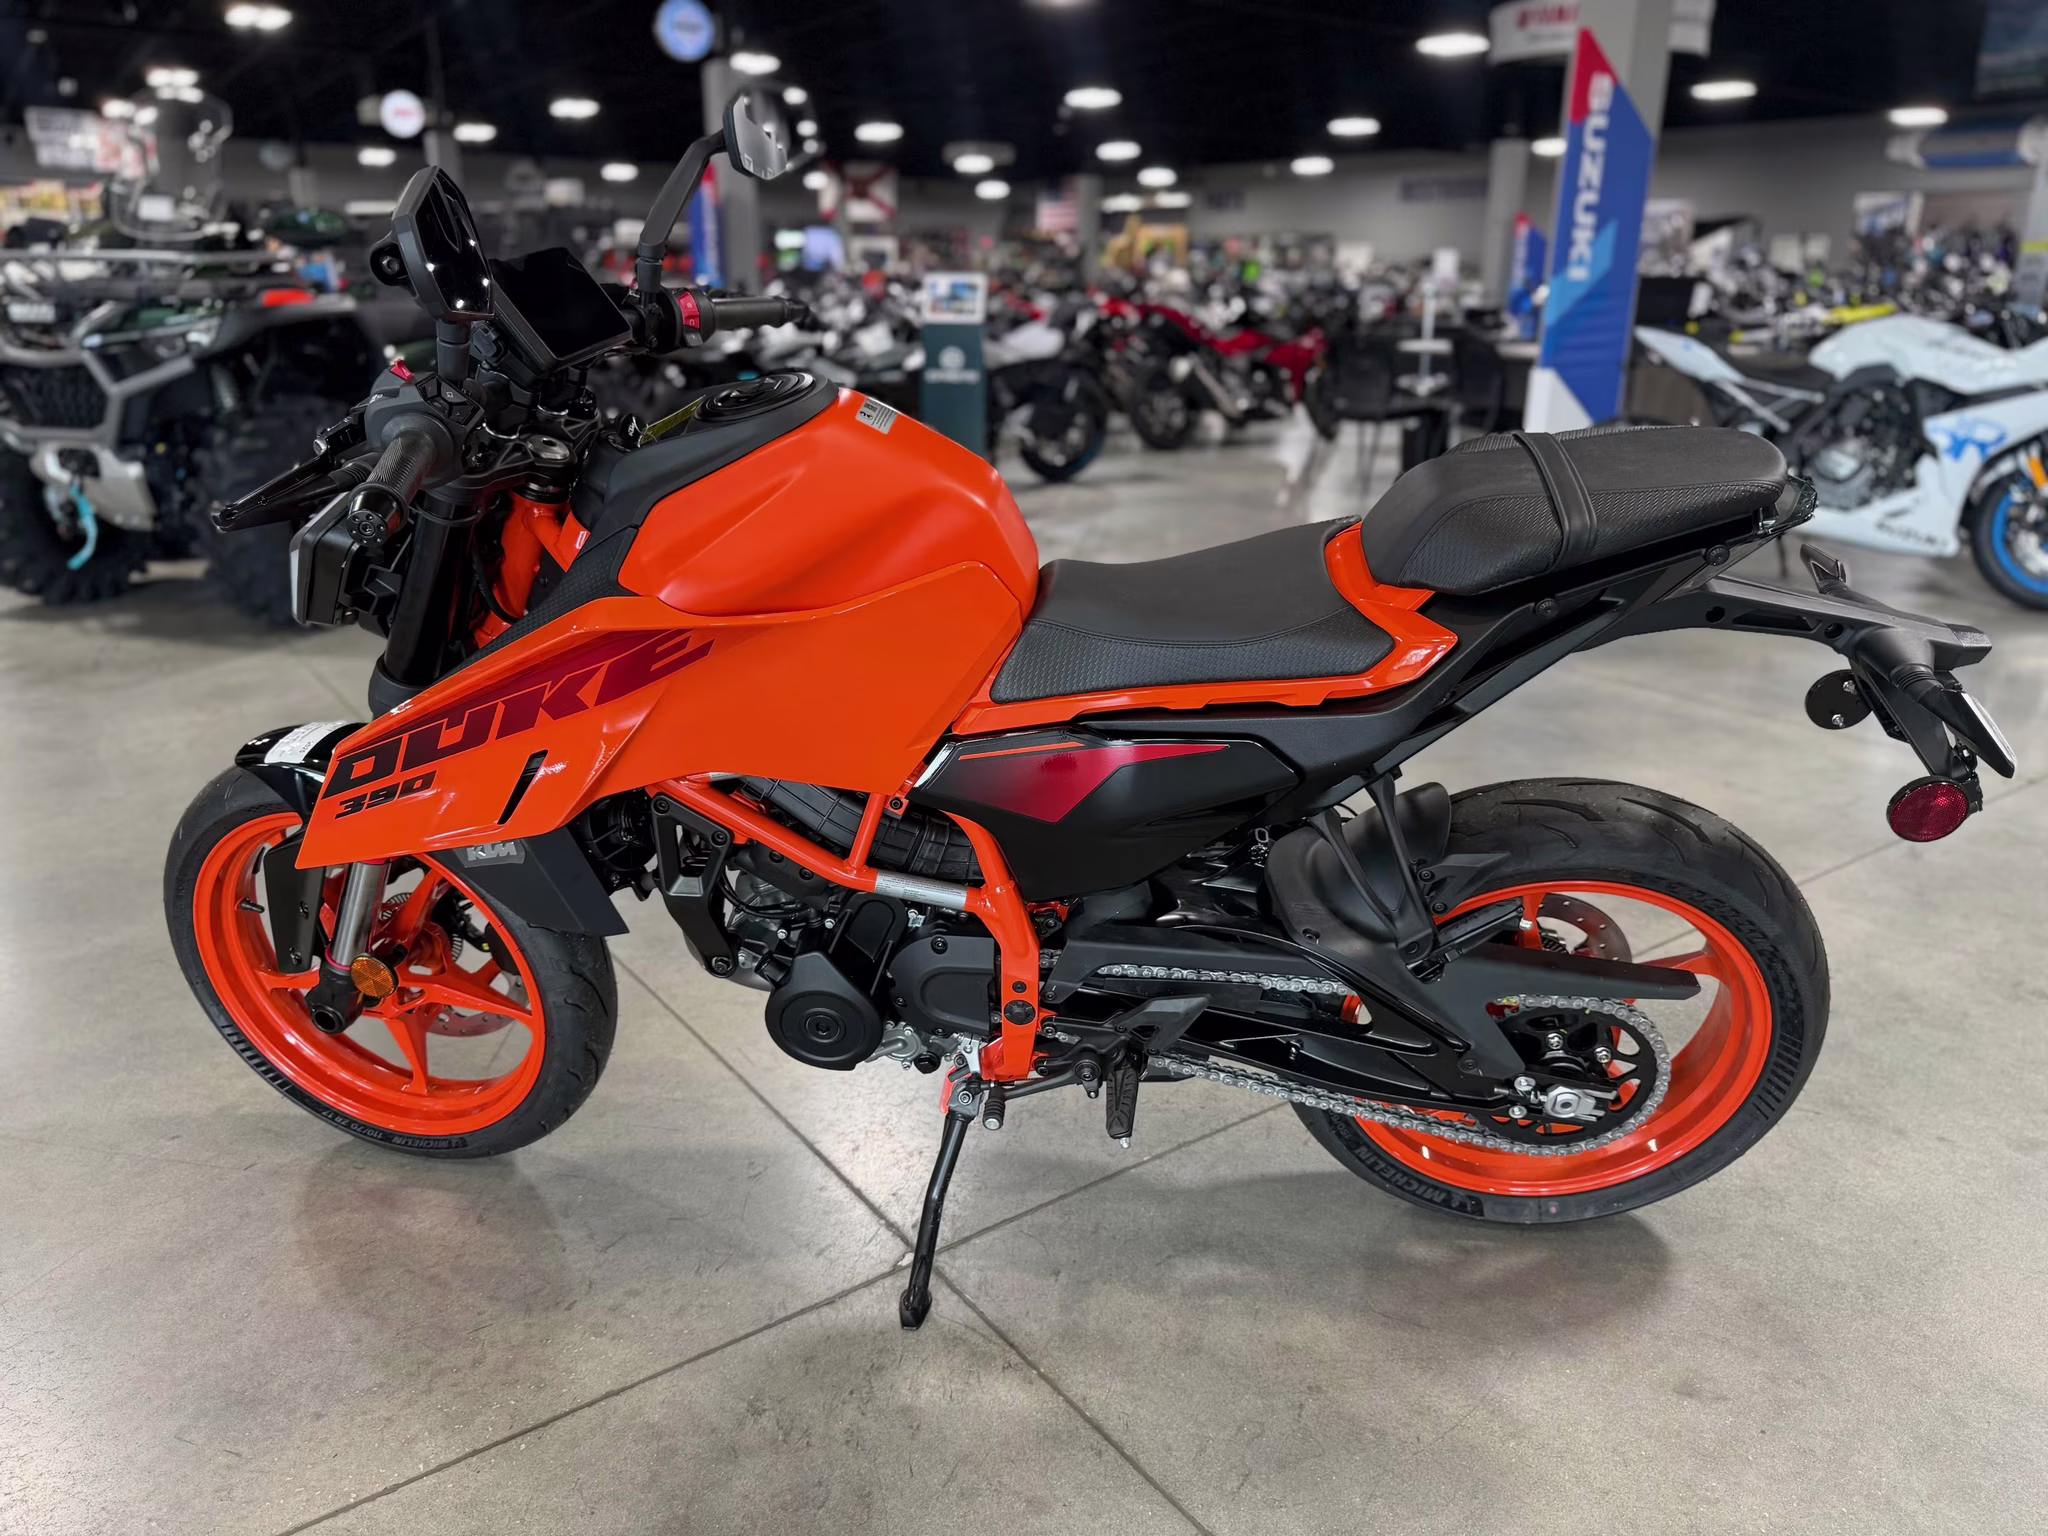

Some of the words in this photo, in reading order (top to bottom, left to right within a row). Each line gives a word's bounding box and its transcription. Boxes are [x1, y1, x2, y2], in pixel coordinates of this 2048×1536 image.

[1567, 70, 1615, 281] SUZUKI
[321, 628, 716, 800] DUKE
[335, 771, 437, 819] 390
[466, 842, 518, 862] KTM
[321, 1109, 333, 1120] 17
[335, 1115, 350, 1127] ZR
[351, 1123, 383, 1139] 110/70
[392, 1136, 449, 1149] MICHELIN
[1354, 1144, 1446, 1203] MICHELIN
